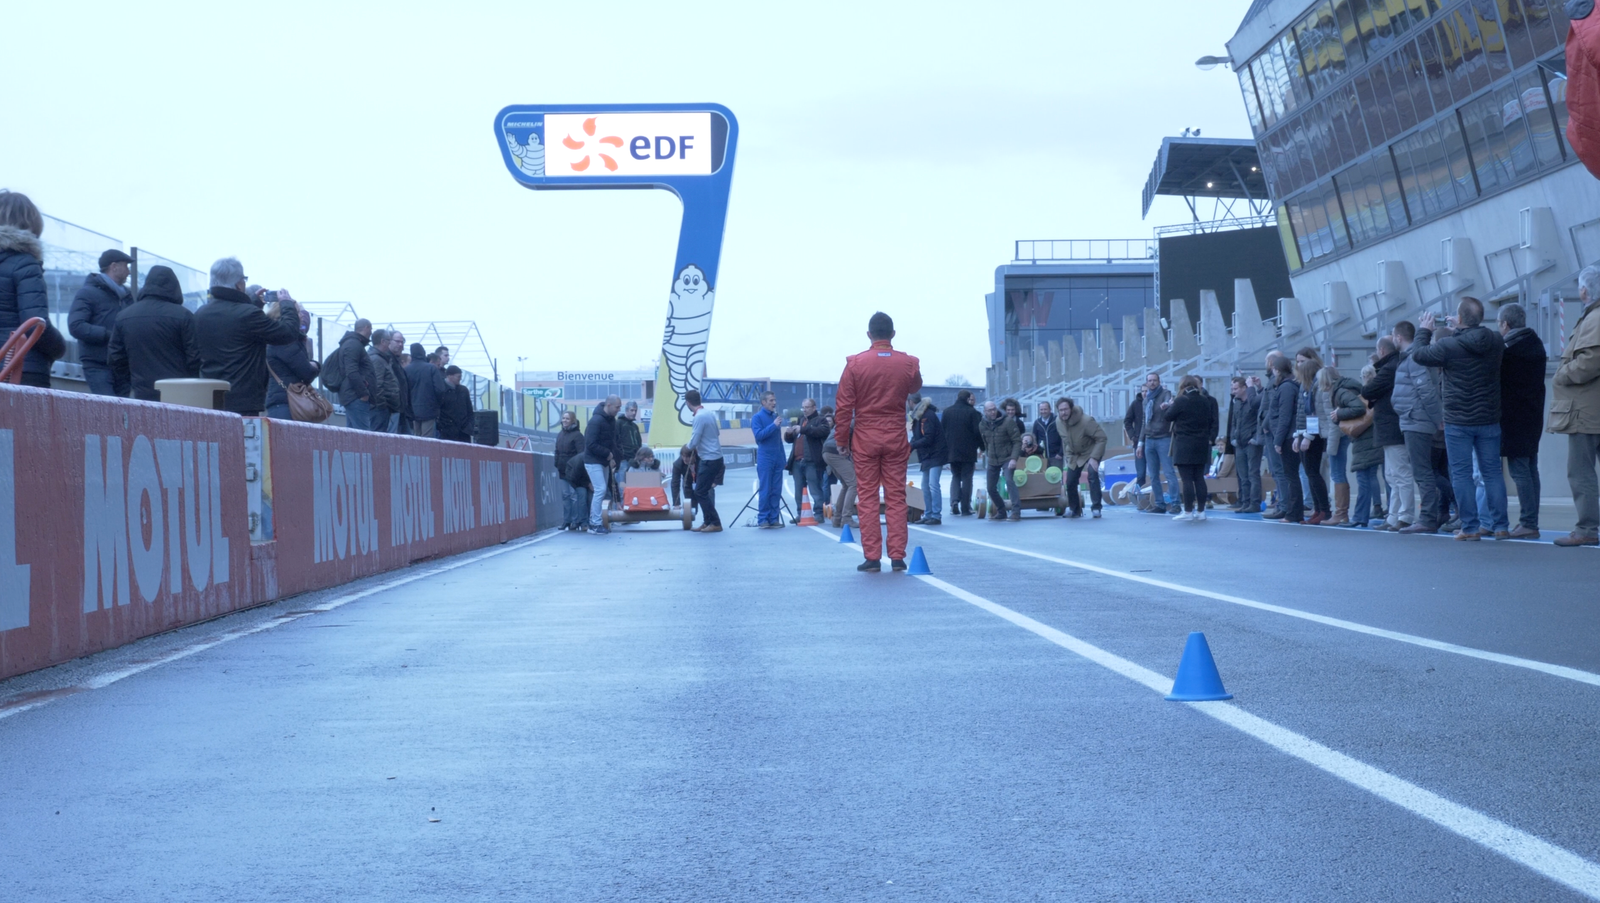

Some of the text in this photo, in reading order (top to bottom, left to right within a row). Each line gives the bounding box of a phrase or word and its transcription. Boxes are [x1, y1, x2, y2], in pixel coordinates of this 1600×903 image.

[557, 371, 615, 381] Bienvenue
[84, 434, 230, 614] MOTUL
[312, 449, 379, 564] MOTUL
[390, 453, 435, 547] MOTUL
[441, 456, 475, 534] MOTUL
